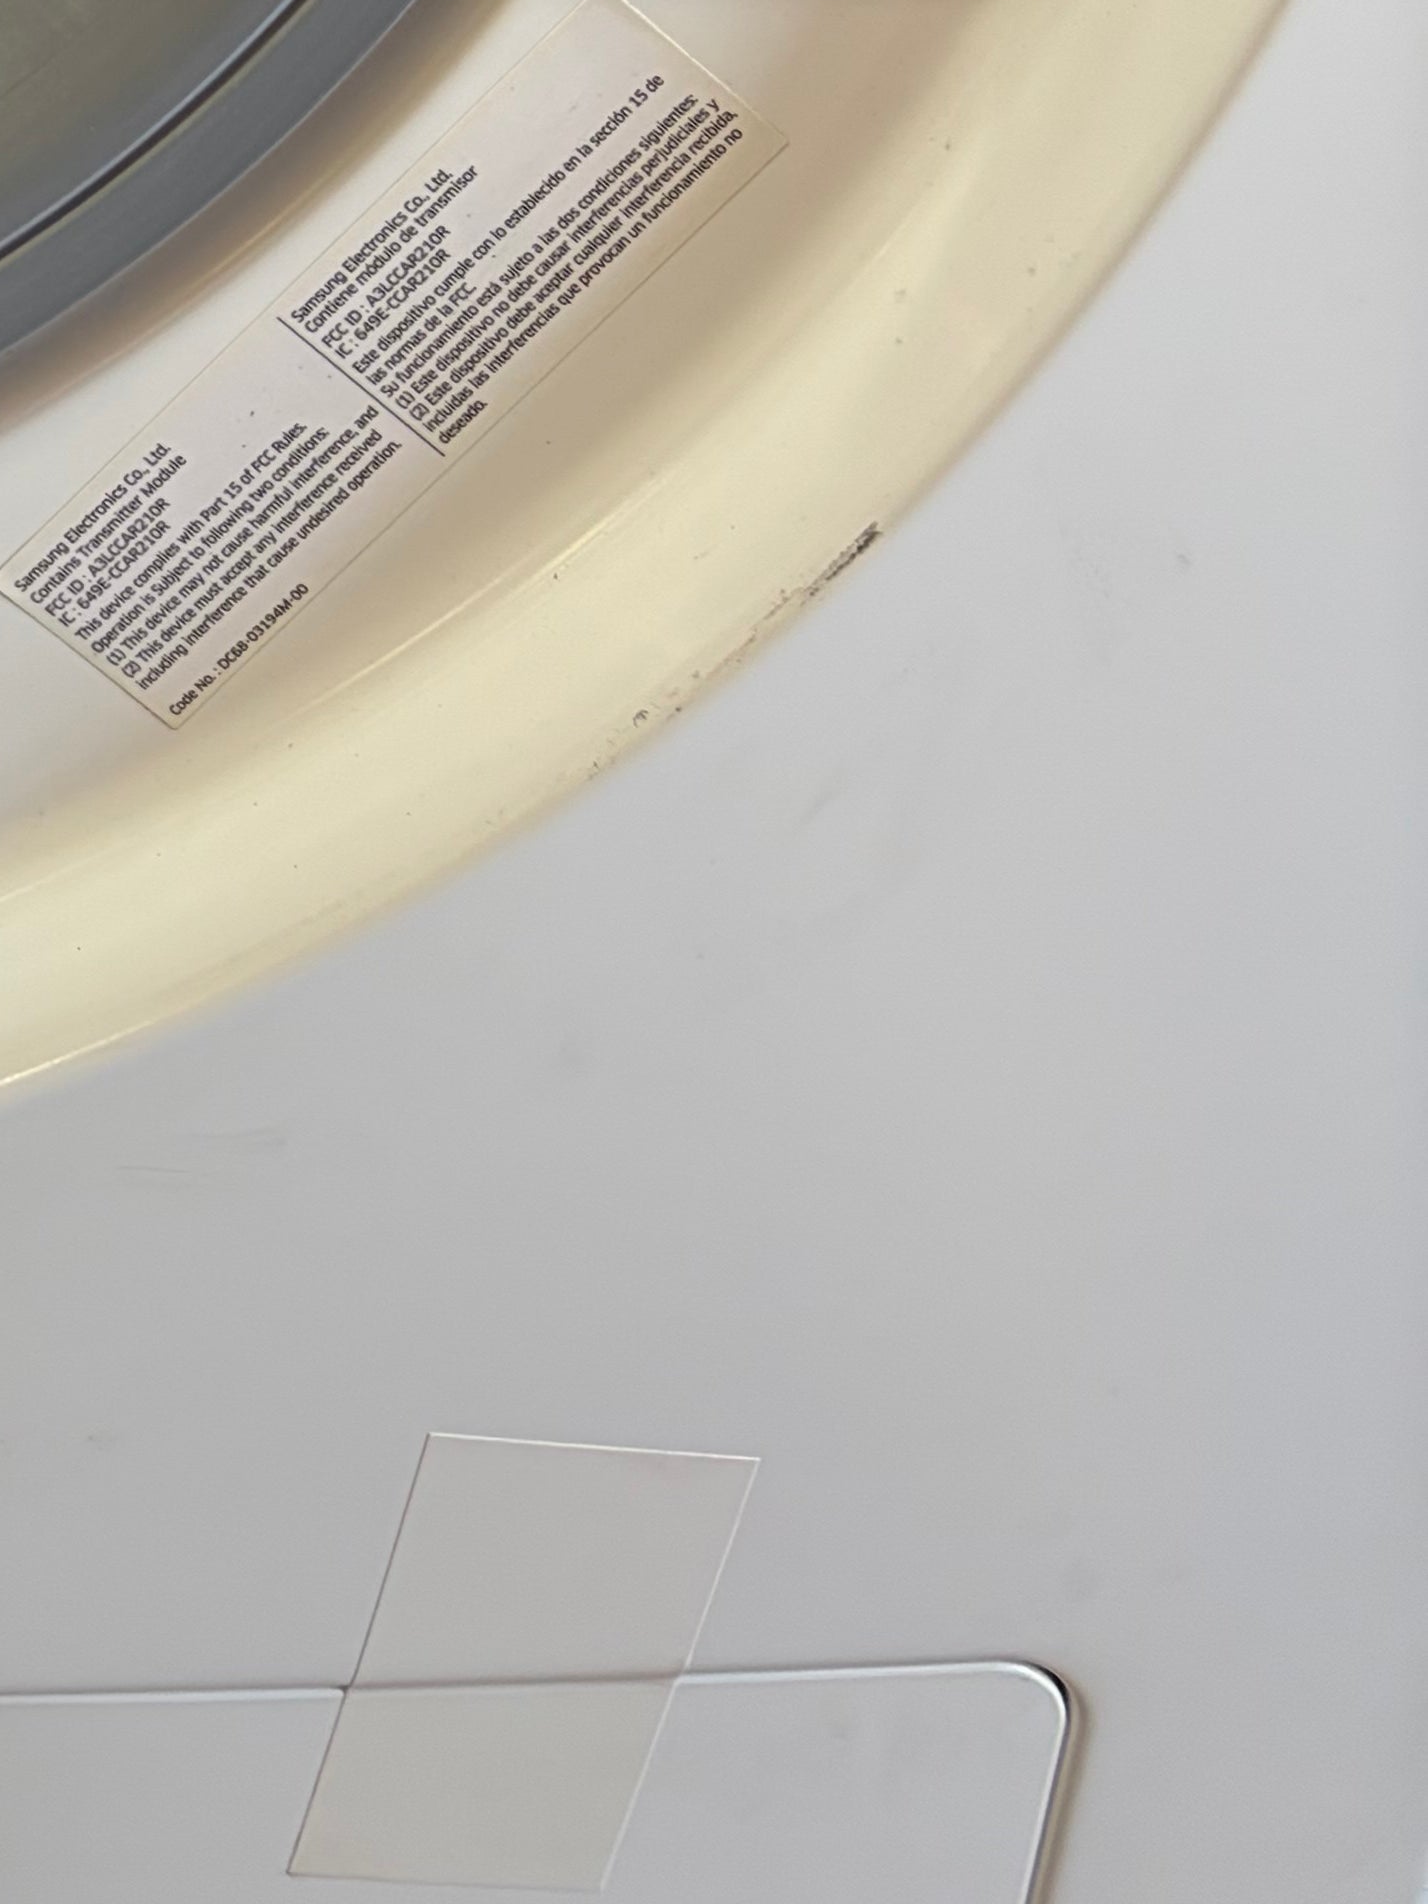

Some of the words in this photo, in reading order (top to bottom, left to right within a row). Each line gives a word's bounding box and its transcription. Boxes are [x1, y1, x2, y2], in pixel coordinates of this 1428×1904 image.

[290, 270, 349, 325] Samsung
[341, 211, 409, 274] Electronics
[424, 168, 454, 193] Ltd.
[299, 276, 359, 334] Contiene
[351, 241, 402, 286] módulo
[399, 225, 419, 244] de
[413, 165, 478, 228] transmisor
[321, 322, 349, 349] FCC
[343, 309, 363, 327] ID
[365, 225, 451, 308] A3LCCAR210R
[351, 349, 381, 374] Este
[377, 295, 437, 352] dispositivo
[433, 257, 476, 297] cumple
[471, 238, 496, 261] con
[504, 170, 567, 229] establecido
[563, 155, 582, 172] en
[589, 106, 633, 148] sección
[628, 88, 649, 108] 15
[645, 75, 665, 93] de
[334, 342, 353, 360] IC
[353, 248, 452, 341] 649E-CCAR210R
[14, 541, 70, 593] Samsung
[63, 484, 129, 545] Electronics
[142, 443, 172, 467] Ltd.
[30, 556, 82, 604] Contains
[75, 494, 143, 558] Transmitter
[139, 455, 187, 498] Module
[44, 591, 72, 617] FCC
[66, 578, 85, 596] ID
[87, 497, 171, 578] A3LCCAR210R
[57, 611, 77, 628] IC
[76, 520, 171, 610] 649E-CCAR210R
[90, 603, 146, 654] Operation
[150, 556, 194, 597] Subject
[200, 499, 255, 549] following
[248, 479, 275, 502] two
[169, 689, 199, 716] Code
